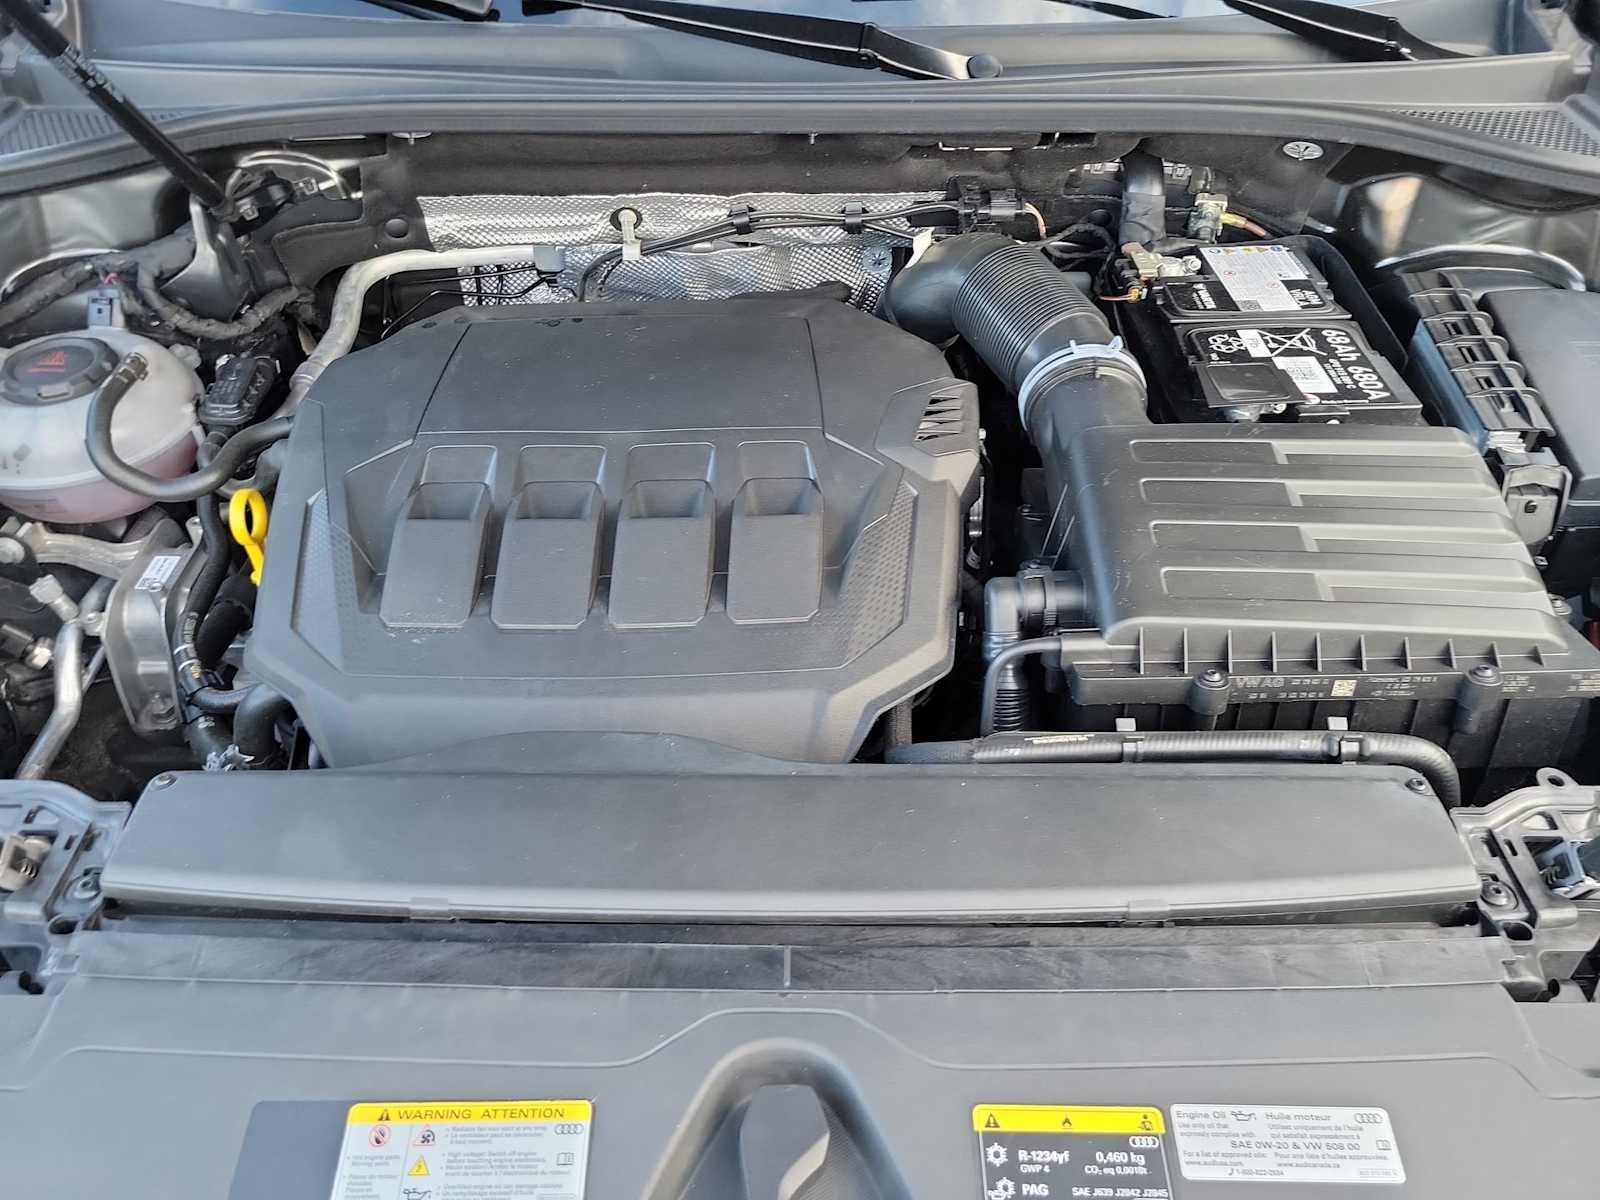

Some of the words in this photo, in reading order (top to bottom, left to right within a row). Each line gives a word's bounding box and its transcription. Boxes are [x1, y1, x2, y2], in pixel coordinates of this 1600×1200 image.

[1302, 289, 1323, 305] AGM
[1321, 329, 1361, 361] 68Ah
[1347, 366, 1391, 400] 680A
[398, 1109, 472, 1120] WARNING
[480, 1108, 565, 1119] ATTENTION
[1176, 1110, 1209, 1120] Engine
[1213, 1111, 1226, 1119] Oil
[1265, 1112, 1291, 1120] Huile
[1294, 1112, 1331, 1121] moteur
[1231, 1140, 1252, 1149] SAE
[1255, 1141, 1289, 1150] 0W-20
[1292, 1142, 1301, 1150] &
[1303, 1142, 1322, 1150] VW
[1347, 1143, 1360, 1151] 00
[1018, 1149, 1070, 1164] R-1234yf
[1096, 1151, 1128, 1164] 0,460
[1130, 1151, 1145, 1165] kg
[1019, 1164, 1041, 1173] GWP
[1043, 1164, 1050, 1173] 4
[1022, 1183, 1049, 1196] PAG
[1072, 1187, 1090, 1197] SAE
